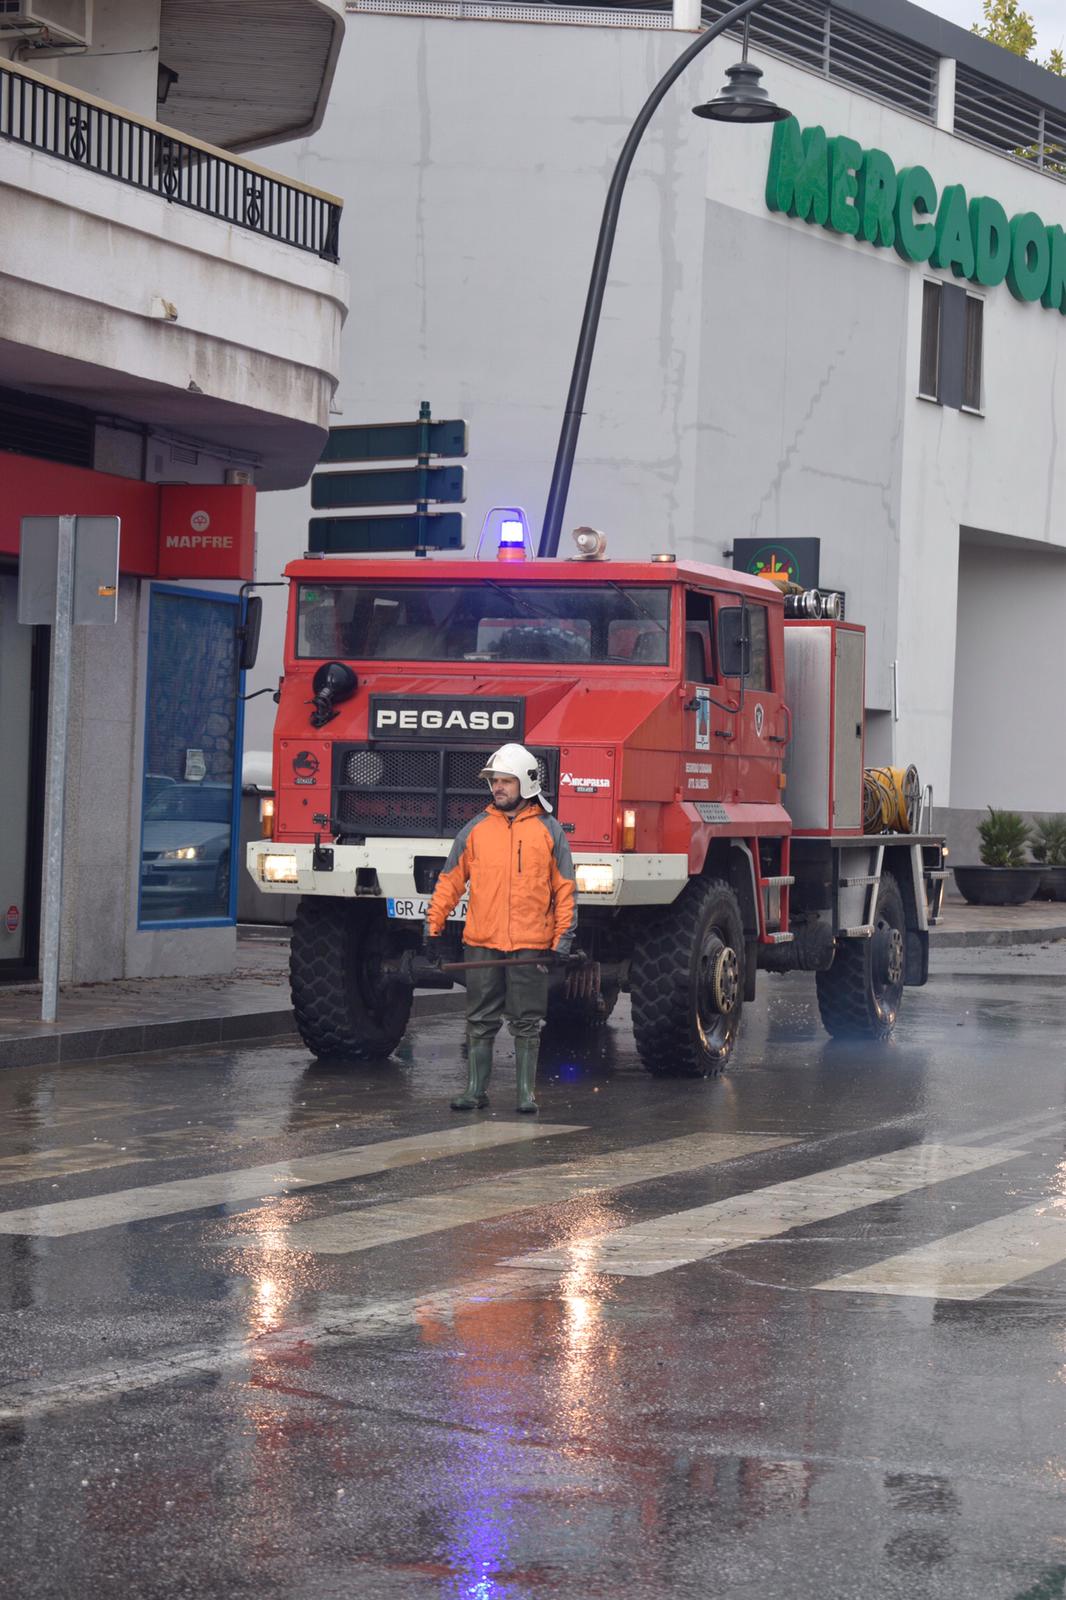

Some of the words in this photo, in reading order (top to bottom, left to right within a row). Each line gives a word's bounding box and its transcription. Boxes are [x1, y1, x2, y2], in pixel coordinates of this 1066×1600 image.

[166, 535, 233, 549] MAPFRE
[376, 710, 515, 730] PEGASO
[395, 900, 414, 916] GR
